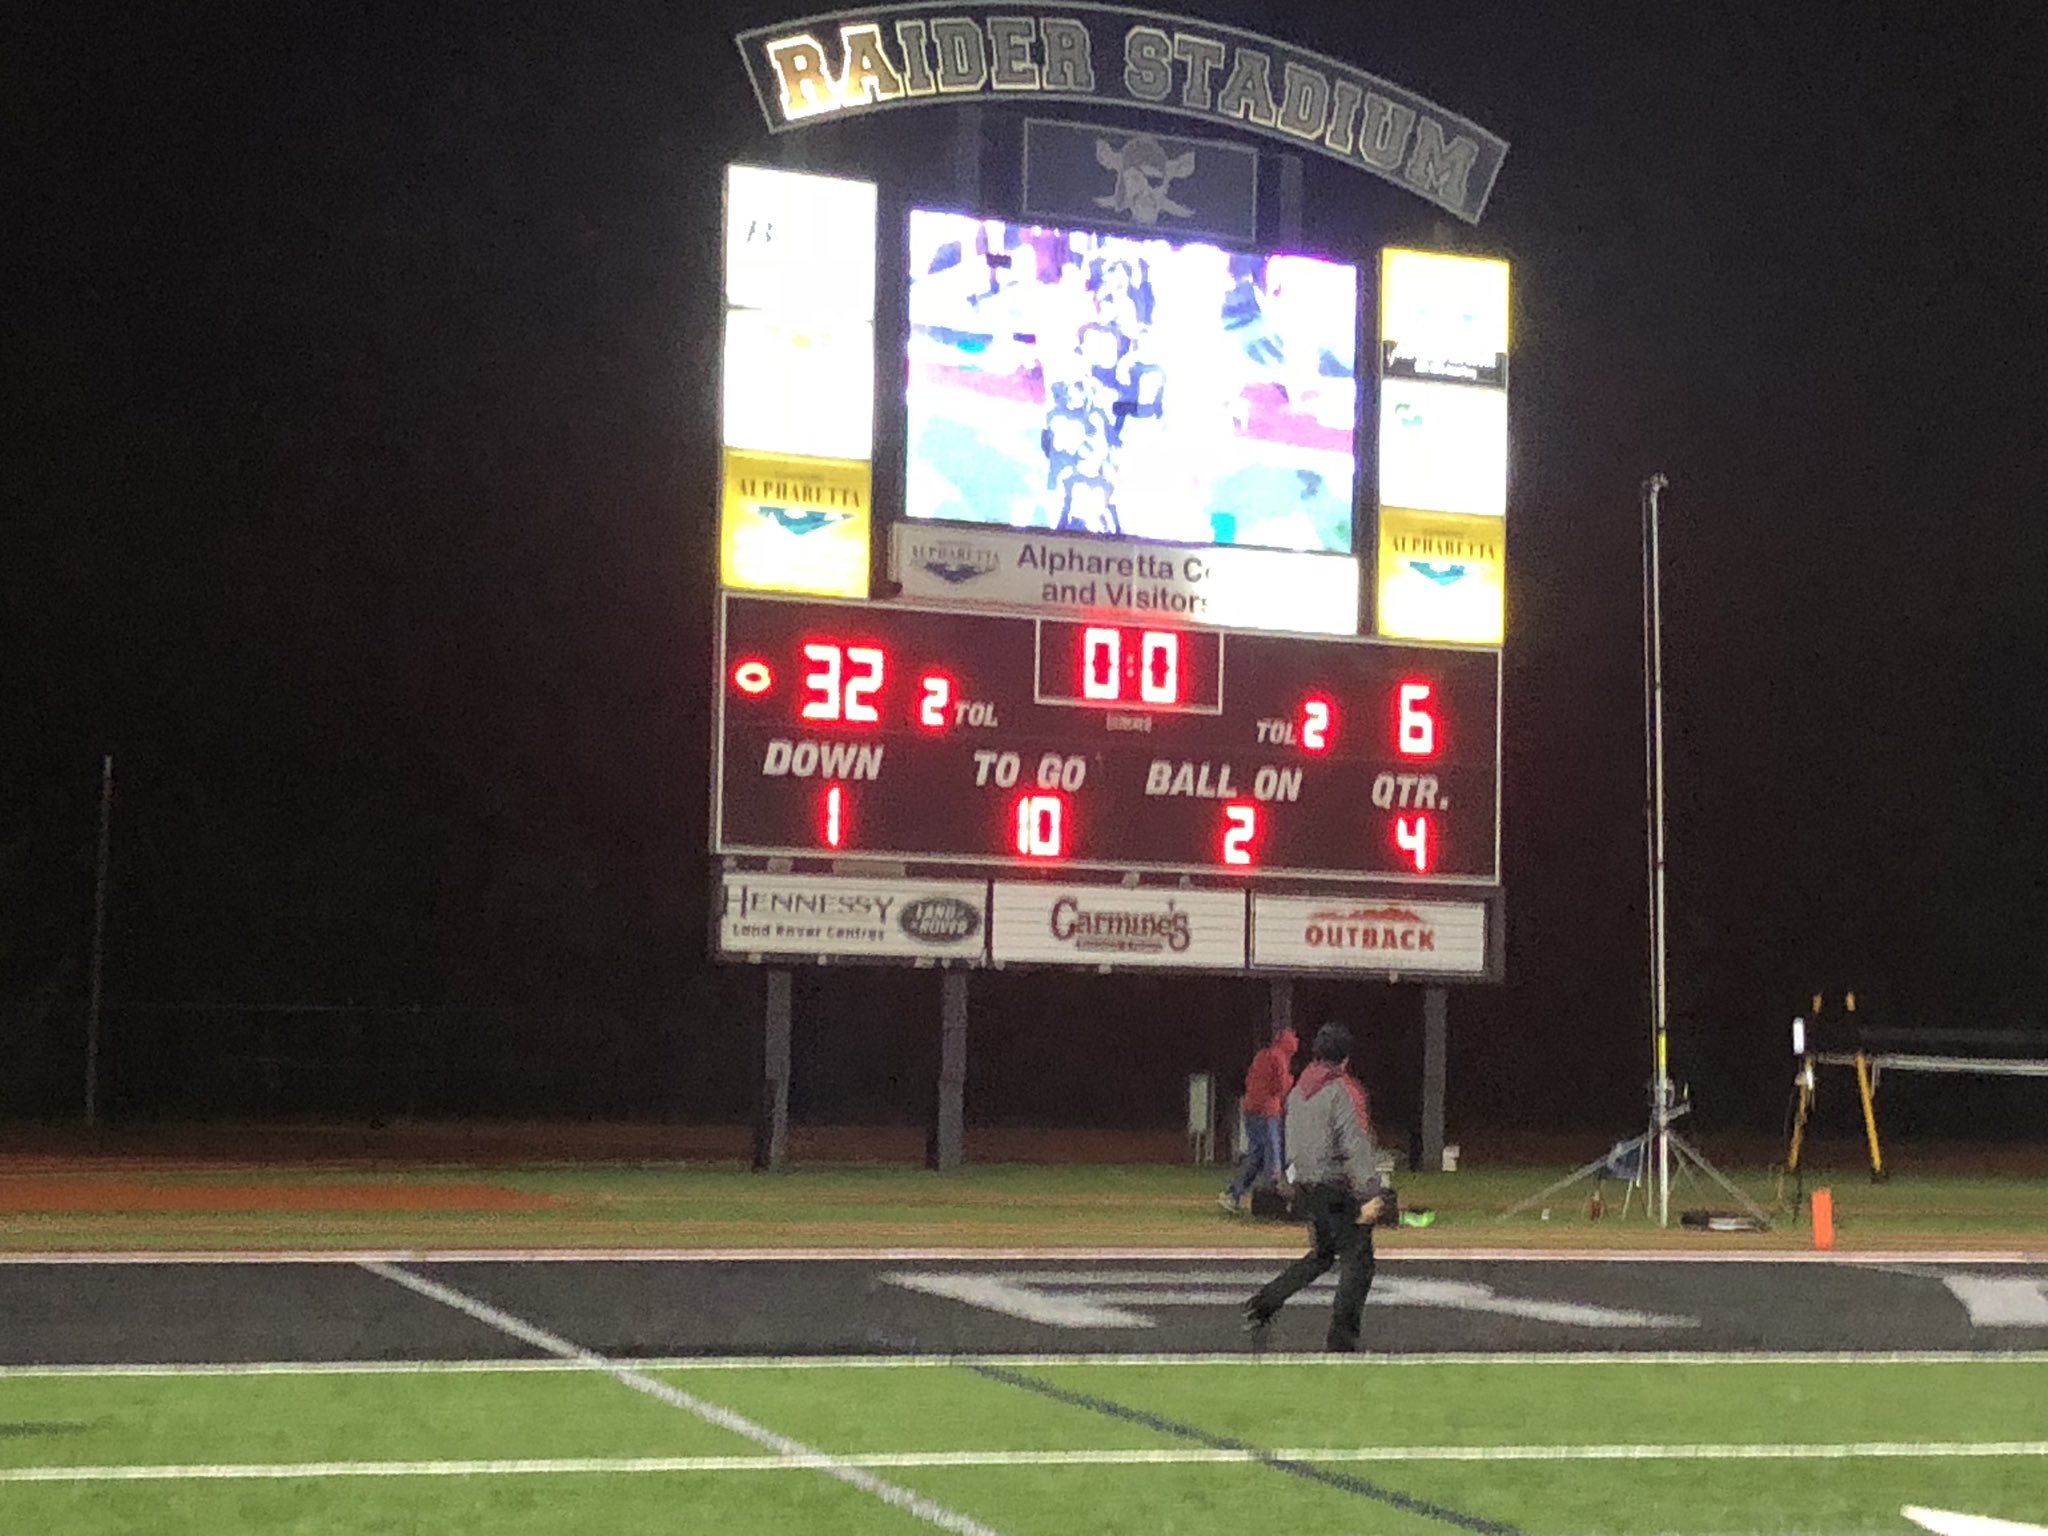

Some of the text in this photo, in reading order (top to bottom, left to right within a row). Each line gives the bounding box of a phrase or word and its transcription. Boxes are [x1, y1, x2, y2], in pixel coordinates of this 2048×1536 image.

[768, 17, 1480, 203] RAIDER STADIUM
[1018, 543, 1174, 581] Alpharetta
[1042, 581, 1096, 606] and
[802, 643, 885, 722] 32
[921, 676, 949, 726] 2
[955, 700, 998, 728] TOL
[1256, 717, 1297, 746] TOL
[1303, 701, 1329, 749] 2
[1399, 683, 1434, 754] 6
[762, 737, 884, 781] DOWN
[974, 750, 1087, 792] TO GO
[1145, 758, 1303, 802] BALL ON
[1371, 772, 1449, 811] QTR.
[826, 786, 841, 847] 1
[1018, 795, 1061, 857] 10
[1223, 805, 1256, 865] 2
[1396, 816, 1427, 871] 4
[723, 884, 894, 925] HENNESSY
[1304, 924, 1436, 952] OUTBACK
